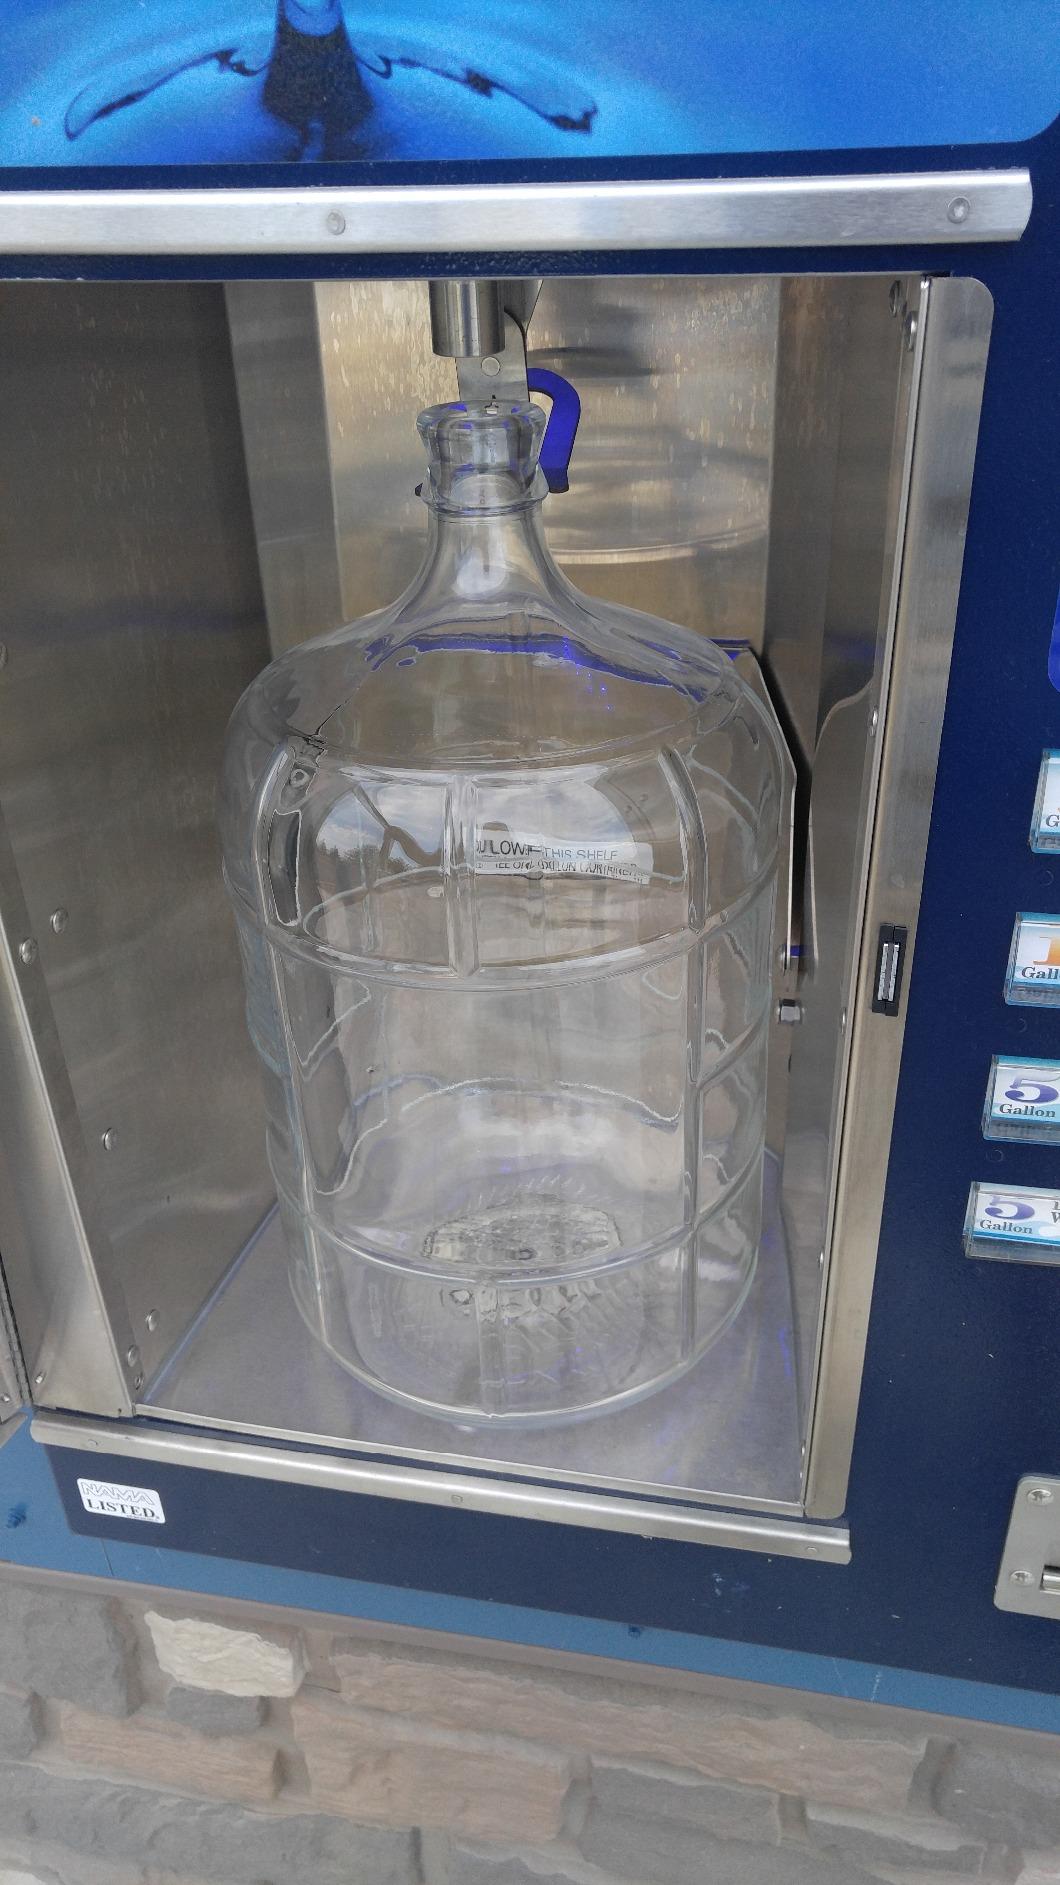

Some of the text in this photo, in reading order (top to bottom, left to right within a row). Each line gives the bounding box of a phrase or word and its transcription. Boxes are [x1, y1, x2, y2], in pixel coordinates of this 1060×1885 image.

[576, 849, 618, 861] SHELF
[1021, 966, 1060, 980] Gall
[1004, 1068, 1060, 1104] 5
[999, 1103, 1056, 1118] Gallon
[984, 1191, 1035, 1221] 5
[979, 1219, 1033, 1234] Gallon
[80, 1481, 155, 1506] NAMA
